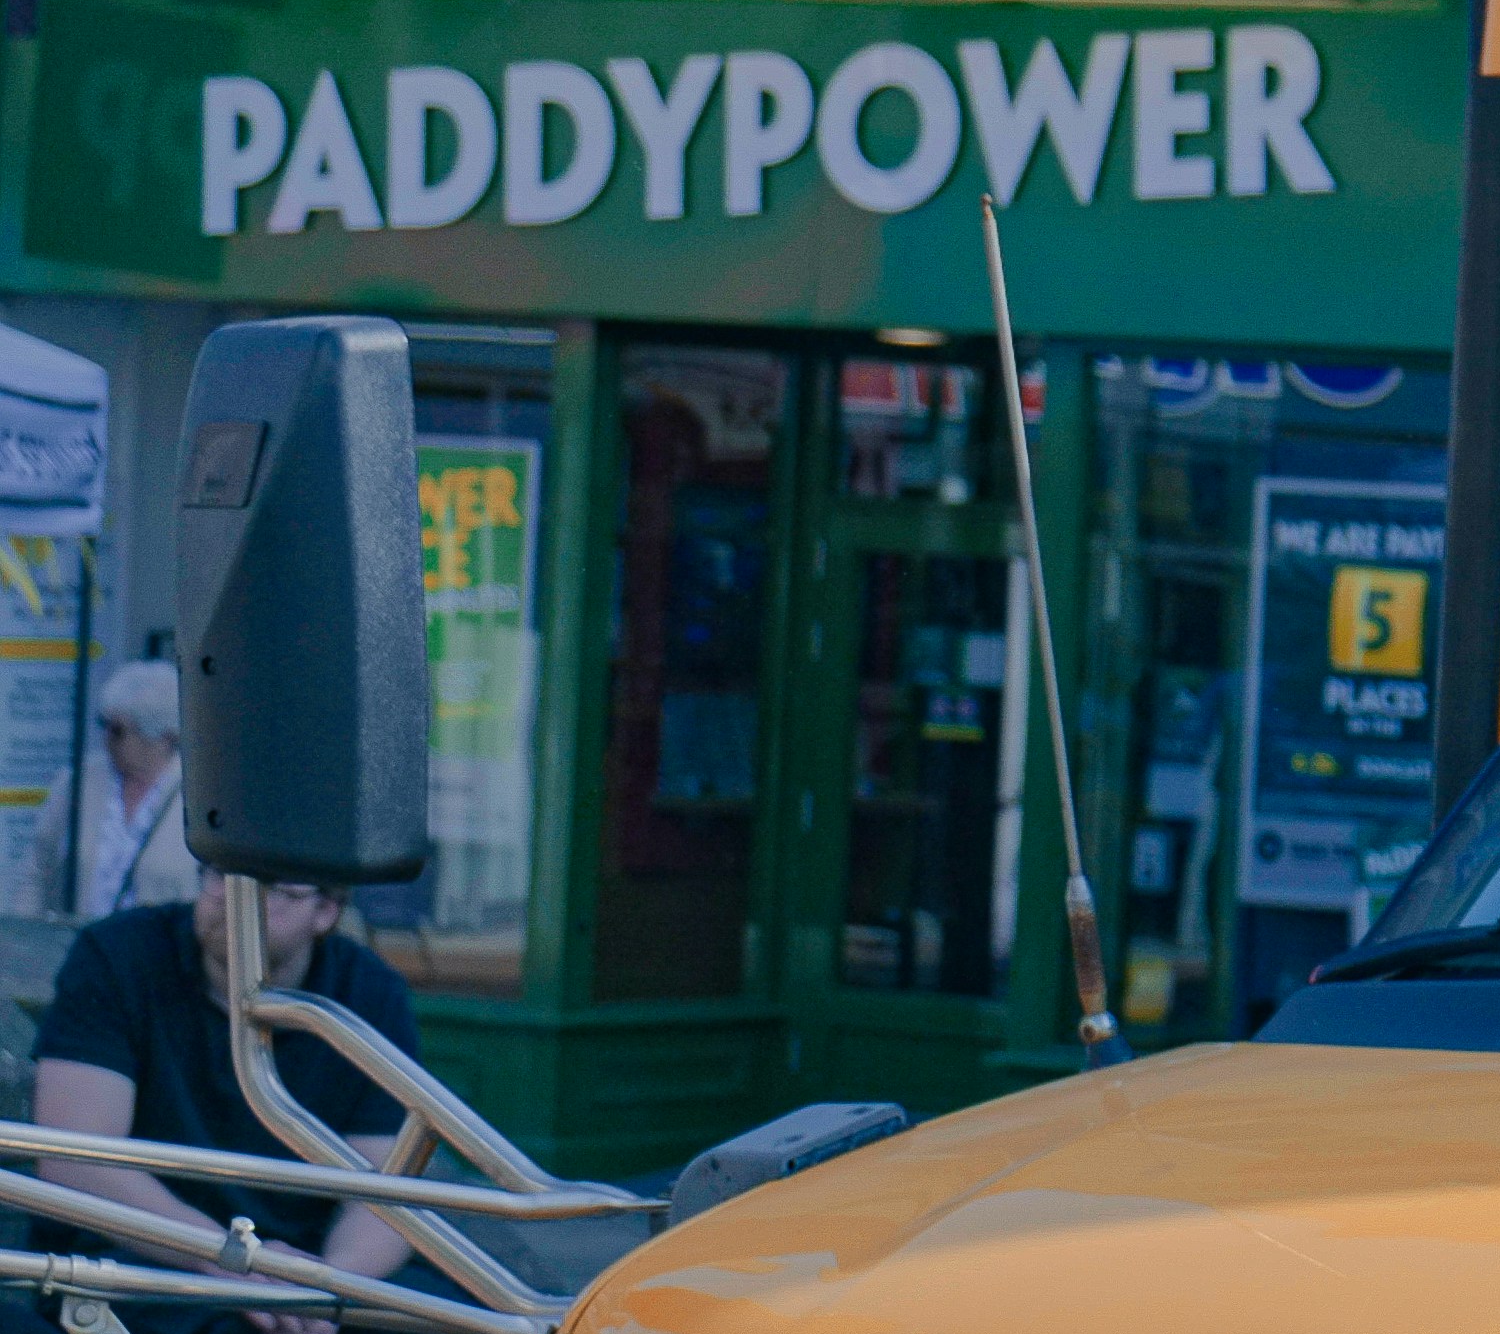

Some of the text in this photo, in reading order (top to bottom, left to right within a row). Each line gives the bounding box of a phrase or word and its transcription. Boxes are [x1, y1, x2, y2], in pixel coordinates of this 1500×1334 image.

[202, 23, 1336, 237] PADDYPOWER
[1325, 521, 1381, 560] ARE
[1358, 590, 1394, 651] 5
[1322, 676, 1430, 721] PLACES
